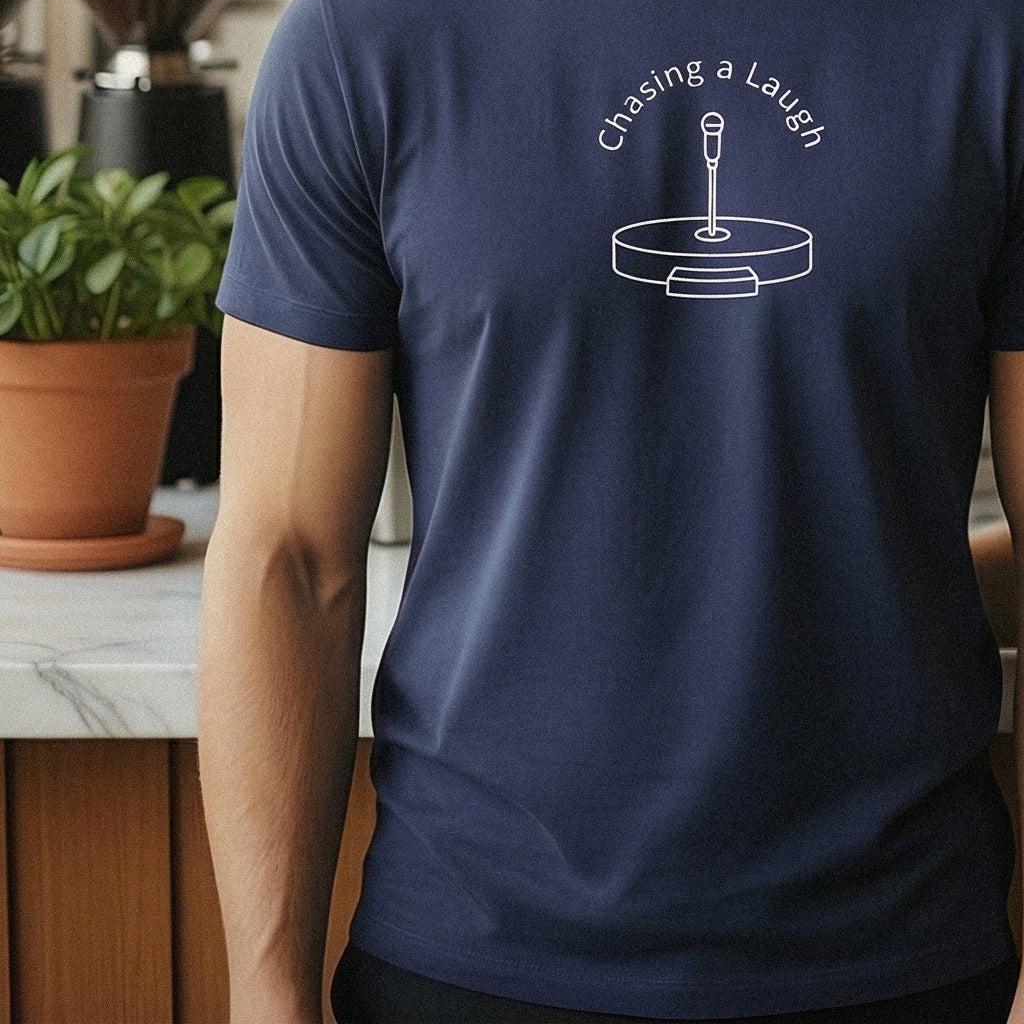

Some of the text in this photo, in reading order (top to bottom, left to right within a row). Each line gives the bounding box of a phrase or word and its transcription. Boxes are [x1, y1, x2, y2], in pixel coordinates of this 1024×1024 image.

[598, 60, 825, 151] Chasing a Laugh
